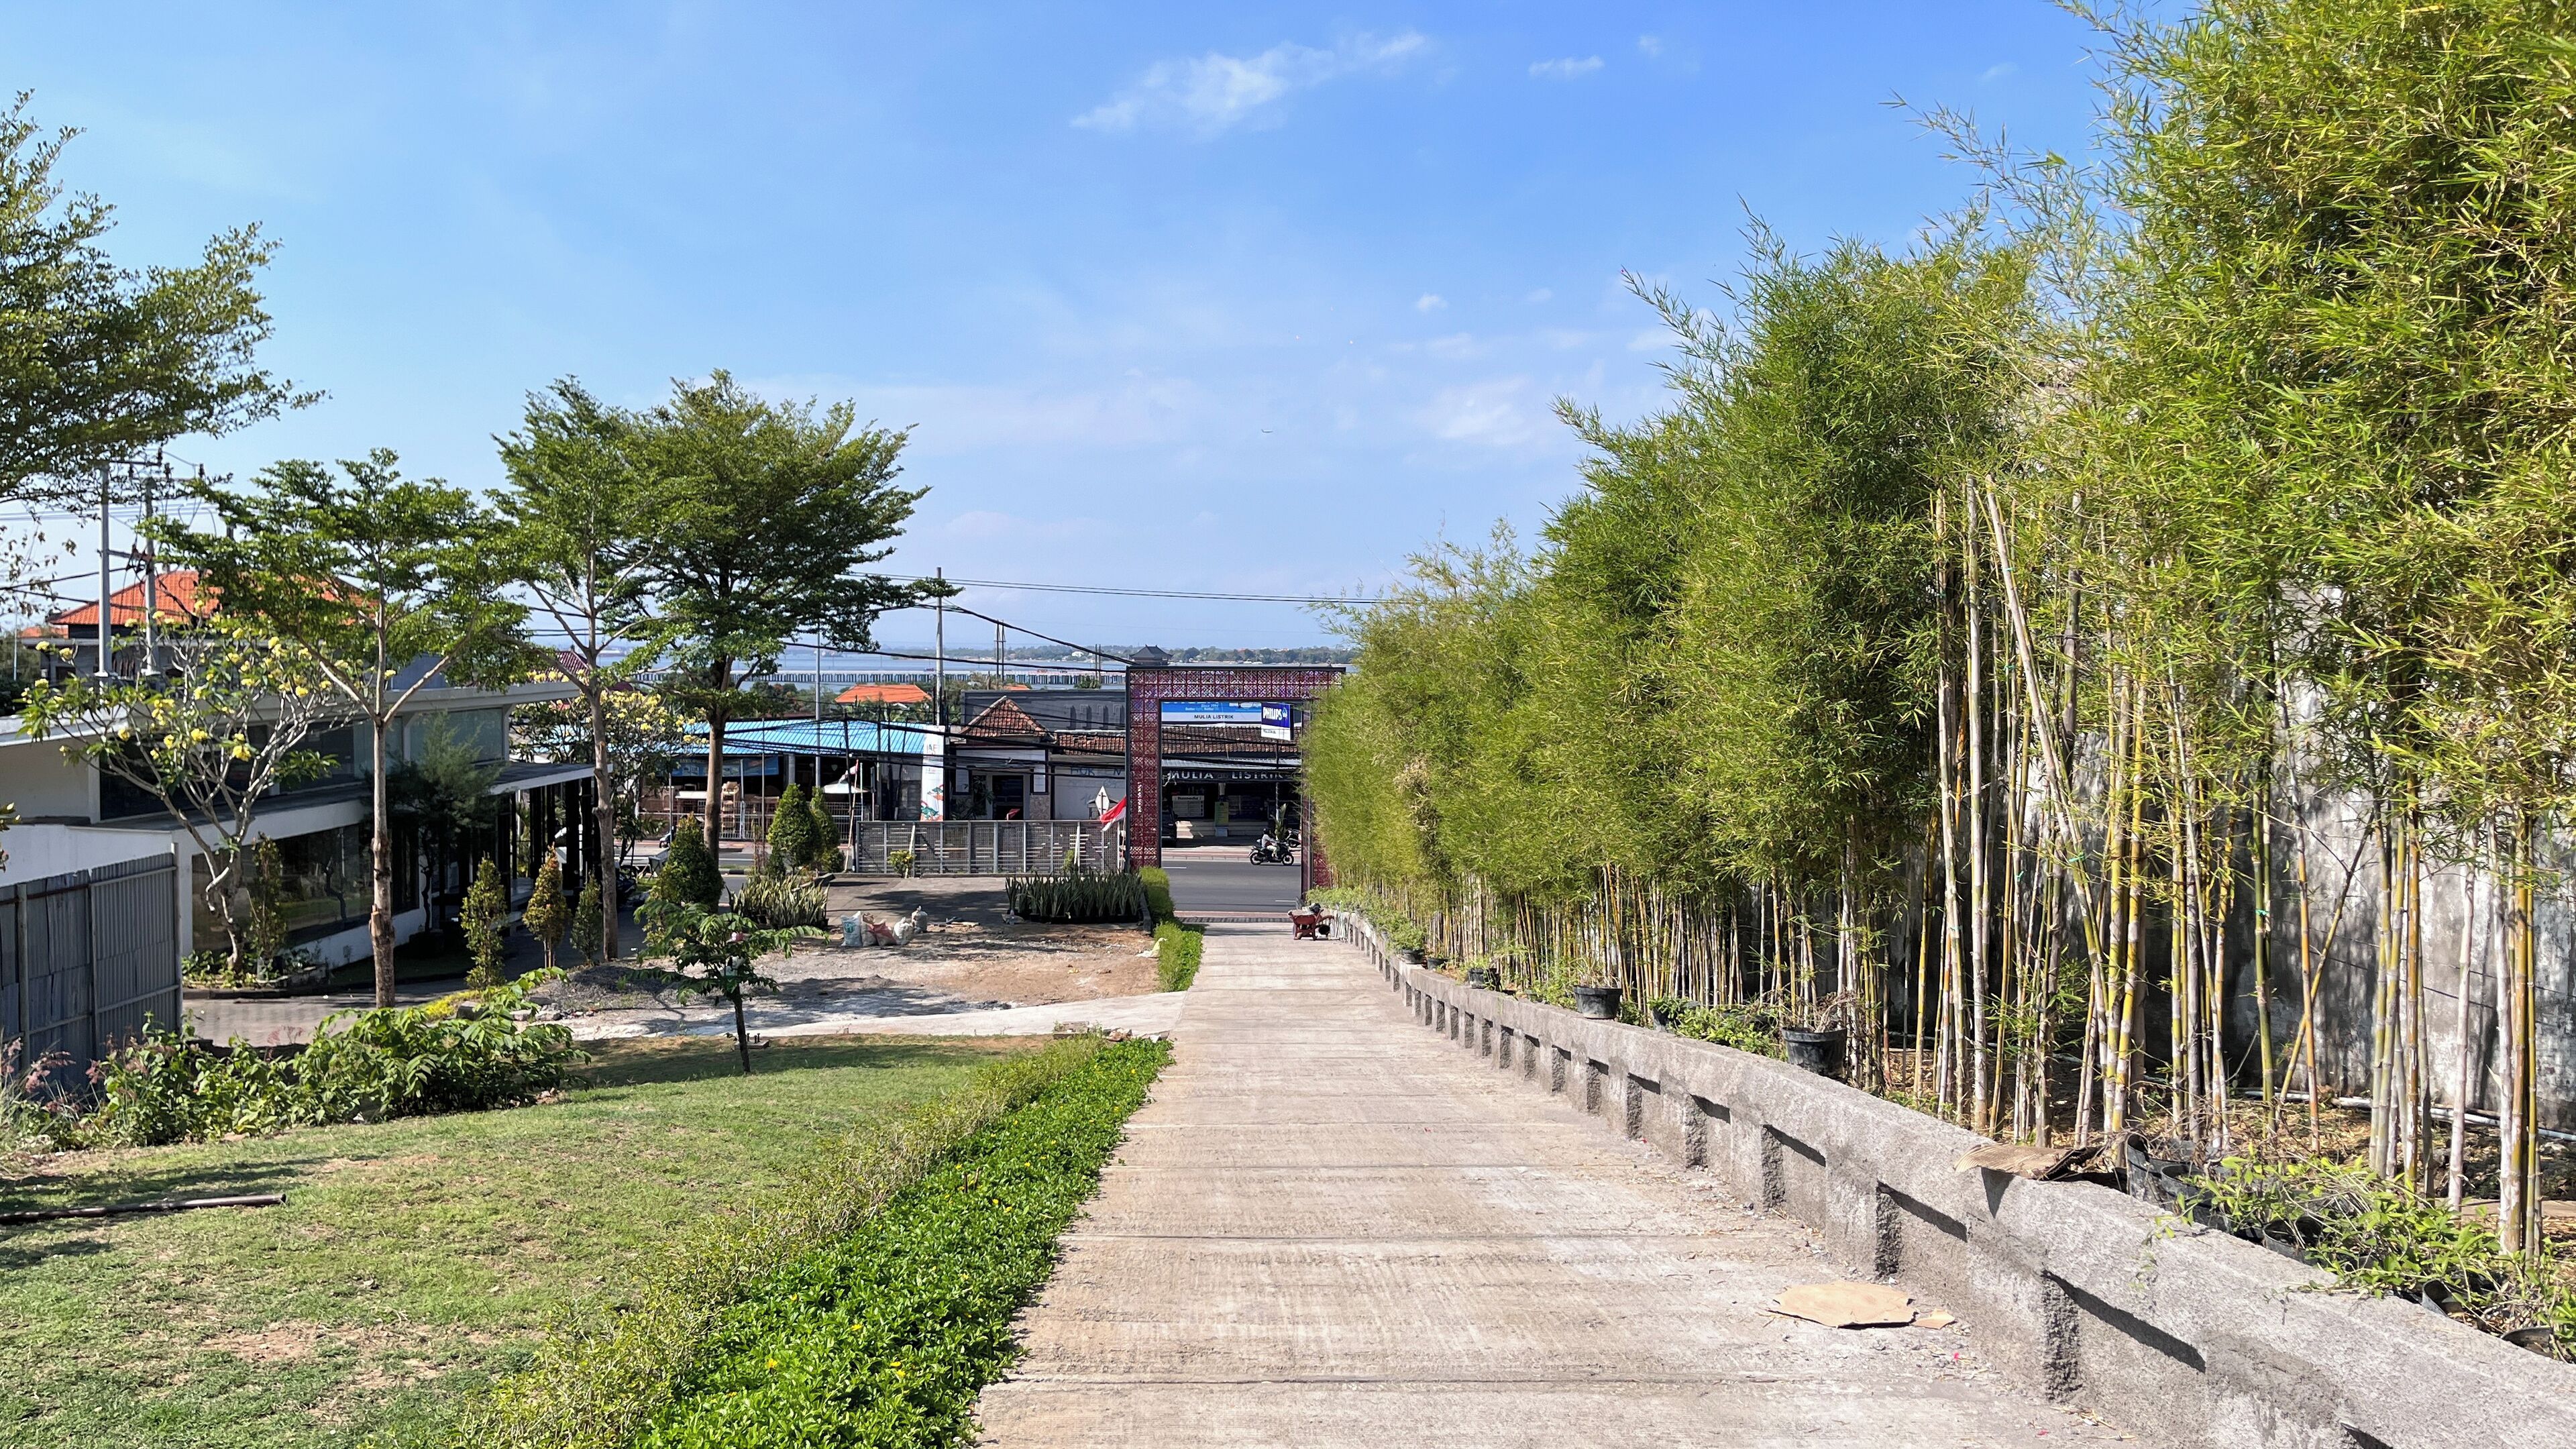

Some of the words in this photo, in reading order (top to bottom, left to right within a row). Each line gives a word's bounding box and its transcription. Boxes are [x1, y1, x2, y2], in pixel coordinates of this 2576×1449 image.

[1263, 706, 1283, 720] PHILIPS
[1170, 771, 1214, 779] MULIA
[1232, 771, 1283, 780] LISTRIK
